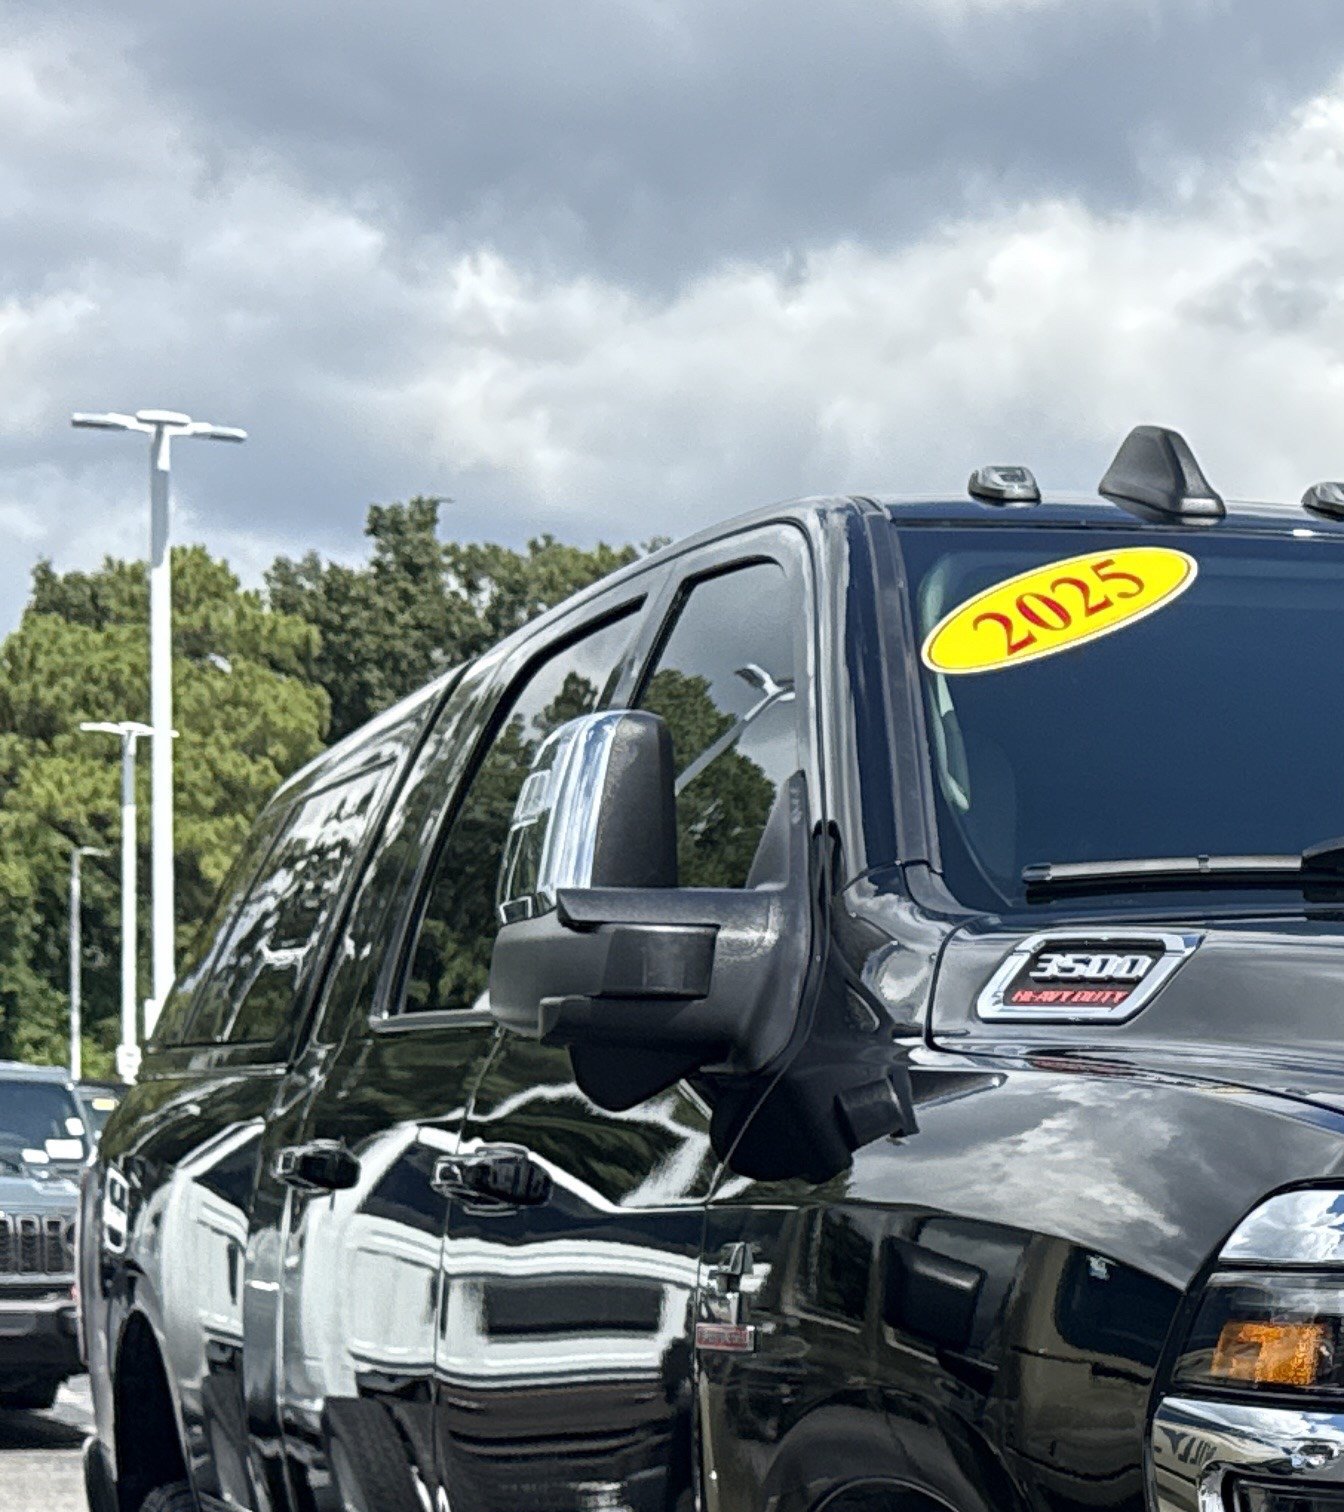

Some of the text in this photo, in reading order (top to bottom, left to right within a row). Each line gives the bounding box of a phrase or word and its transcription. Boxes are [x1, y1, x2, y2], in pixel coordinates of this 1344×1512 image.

[972, 558, 1145, 655] 2025
[1029, 953, 1153, 981] 3500
[1012, 990, 1129, 1003] HEAVY DUTY
